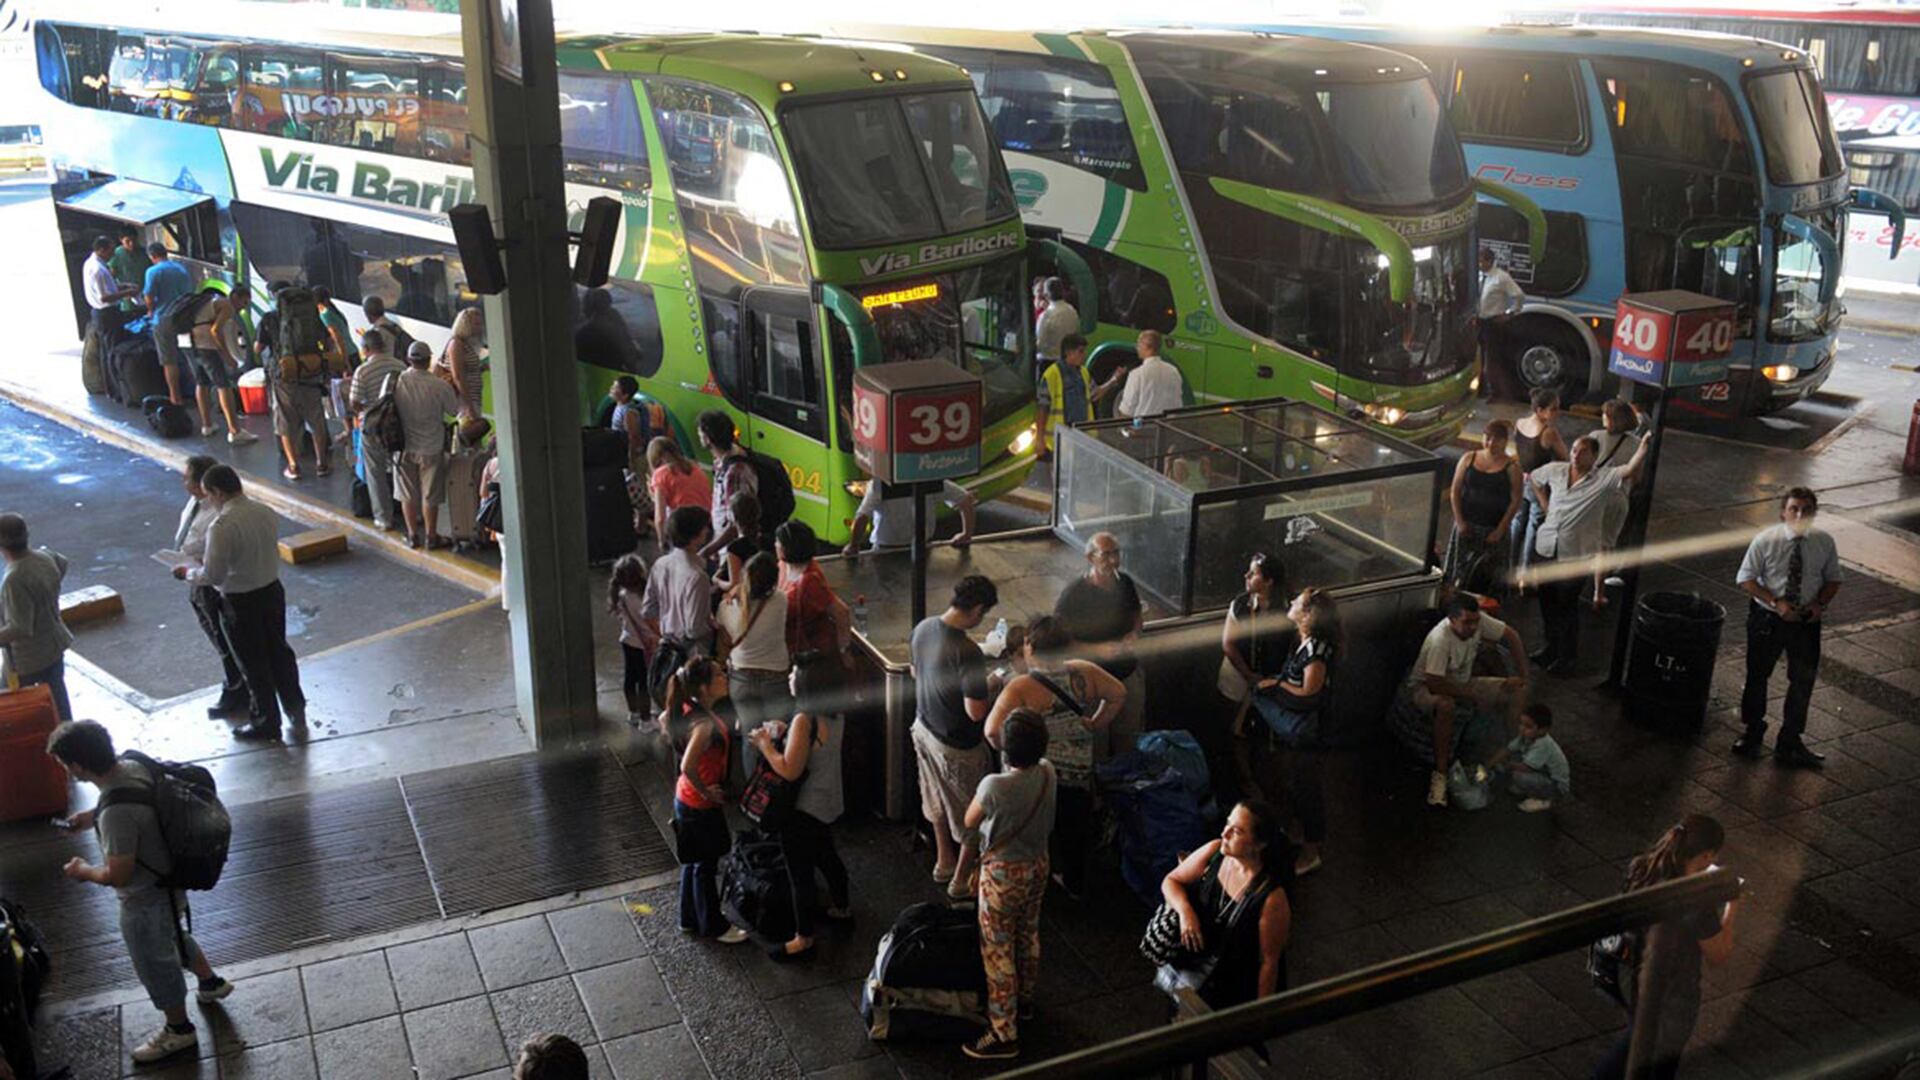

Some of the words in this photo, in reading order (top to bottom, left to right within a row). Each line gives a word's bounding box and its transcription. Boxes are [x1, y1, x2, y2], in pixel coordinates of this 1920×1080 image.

[1475, 164, 1579, 192] Class
[918, 231, 1017, 263] Bariloche
[1617, 313, 1658, 352] 40
[1686, 320, 1731, 355] 40
[909, 401, 971, 445] 39
